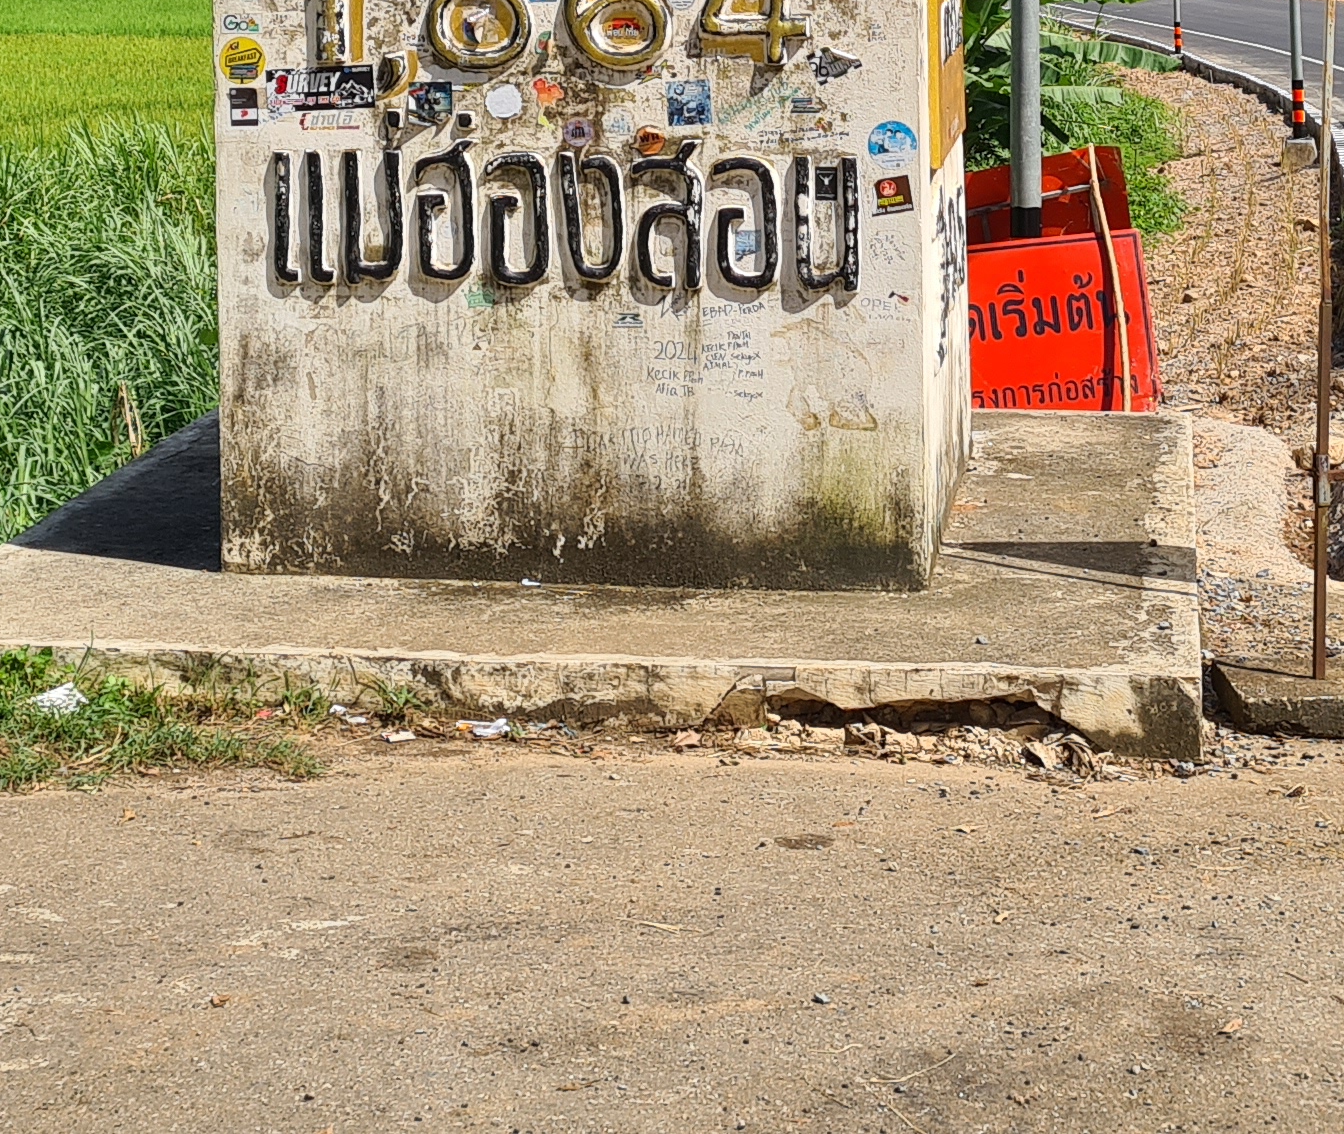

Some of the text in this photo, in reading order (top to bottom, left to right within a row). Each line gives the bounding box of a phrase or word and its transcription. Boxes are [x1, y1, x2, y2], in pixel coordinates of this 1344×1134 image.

[274, 71, 341, 95] SURVEY
[272, 108, 859, 291] แม่ฮ่องสอน
[653, 339, 698, 365] 2024
